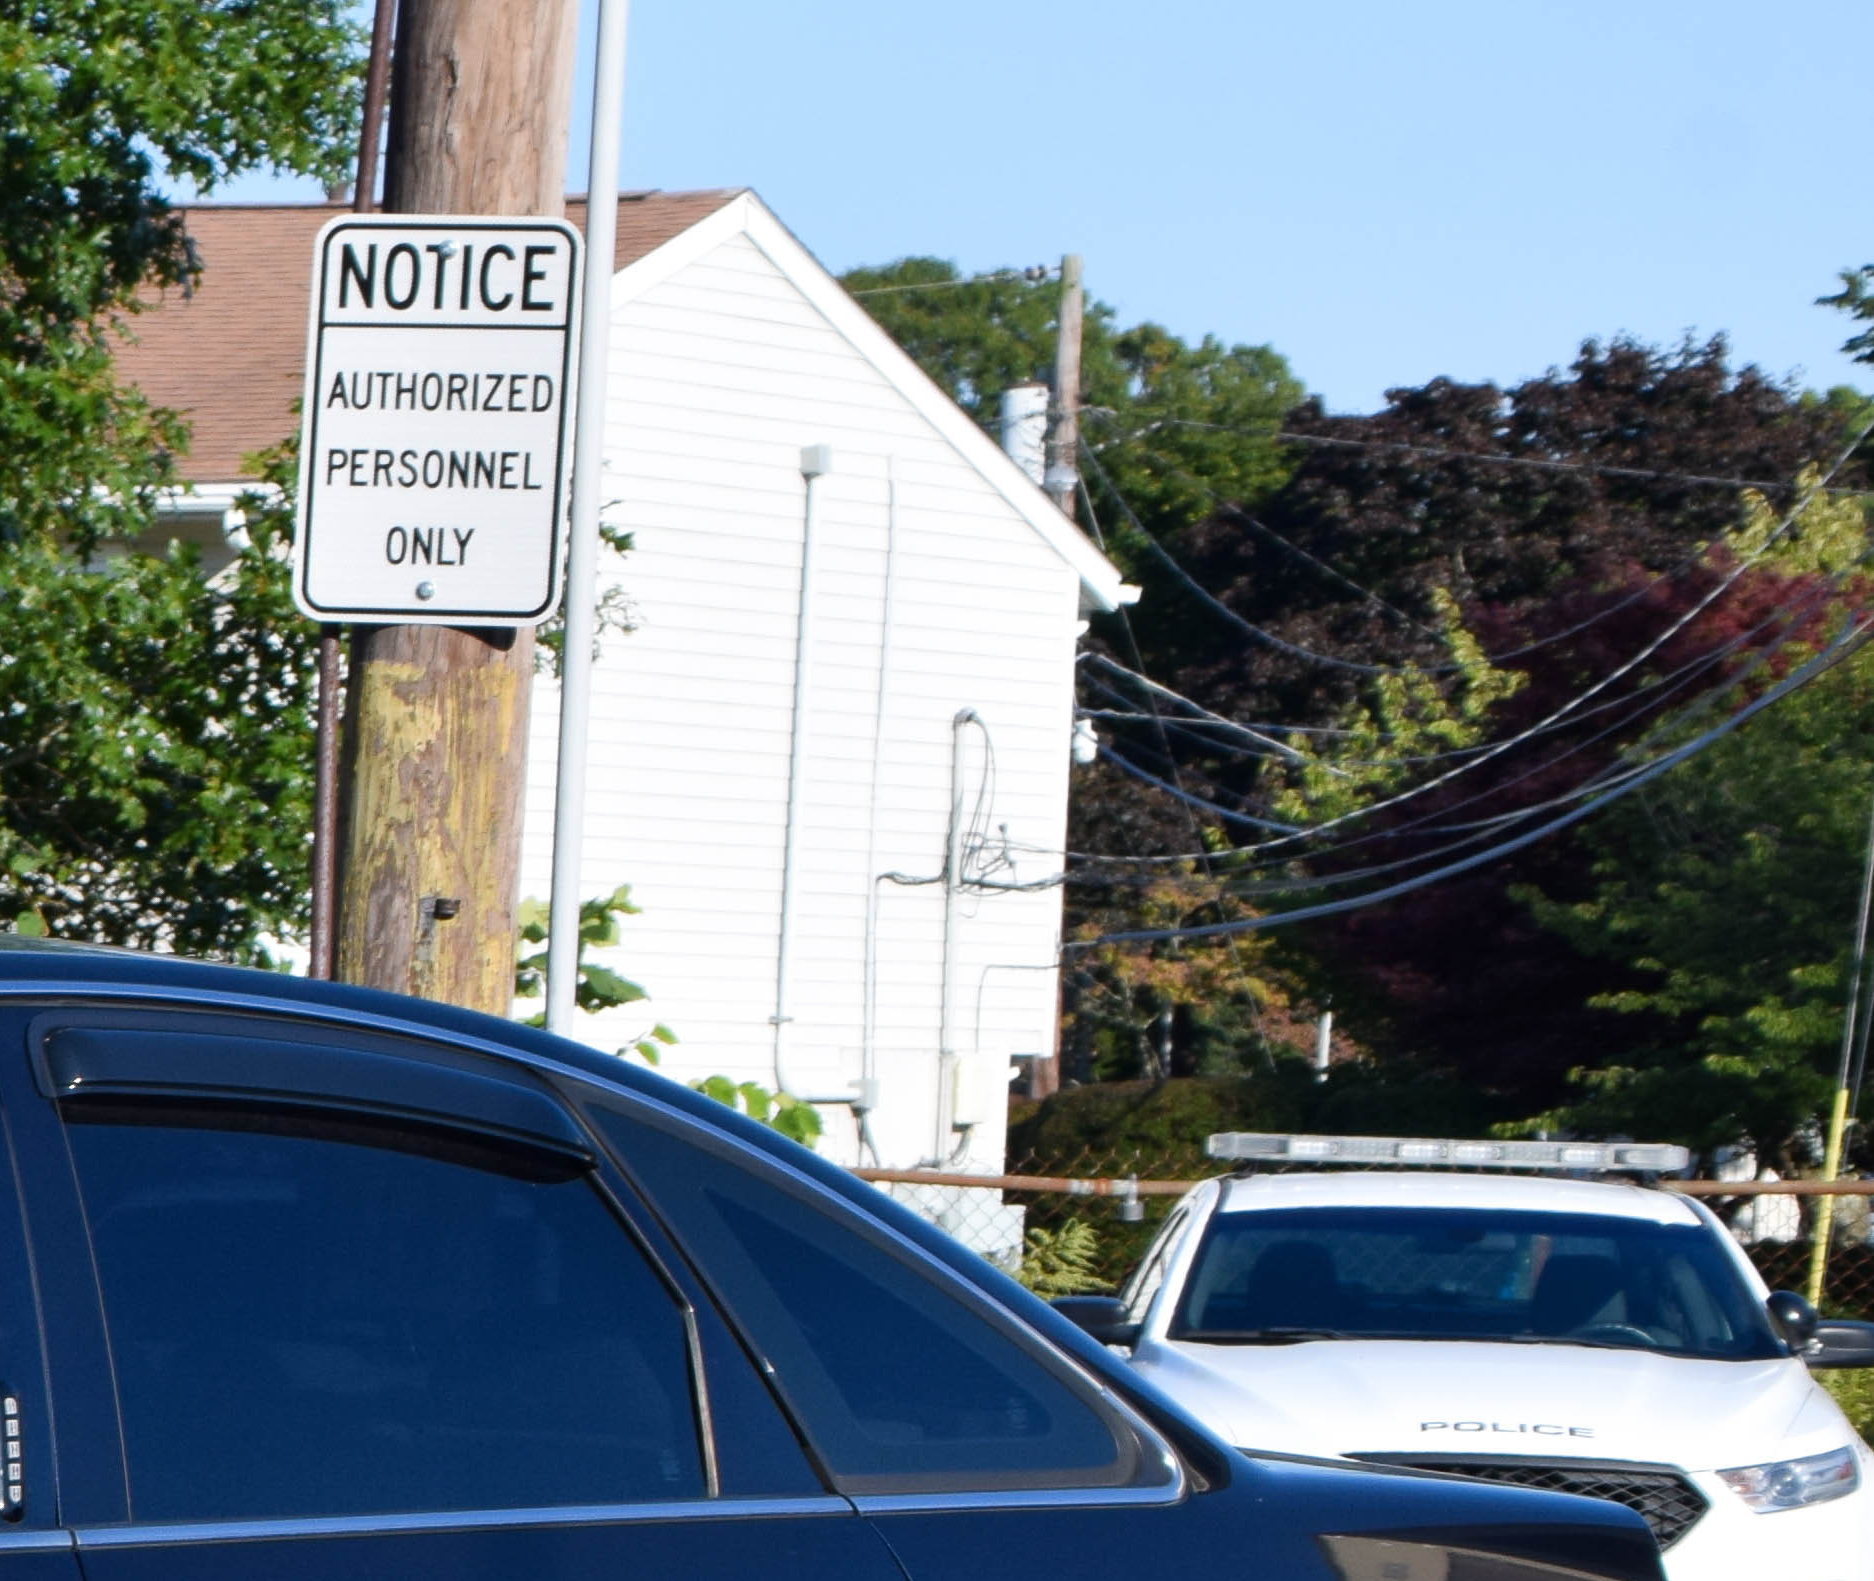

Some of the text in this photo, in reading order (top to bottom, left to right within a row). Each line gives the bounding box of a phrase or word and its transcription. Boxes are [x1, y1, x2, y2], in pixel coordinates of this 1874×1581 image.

[337, 240, 558, 313] NOTICE
[326, 371, 554, 413] AUTHORIZED
[326, 448, 542, 491] PERSONNEL
[385, 526, 475, 567] ONLY
[1420, 1420, 1596, 1439] POLICE
